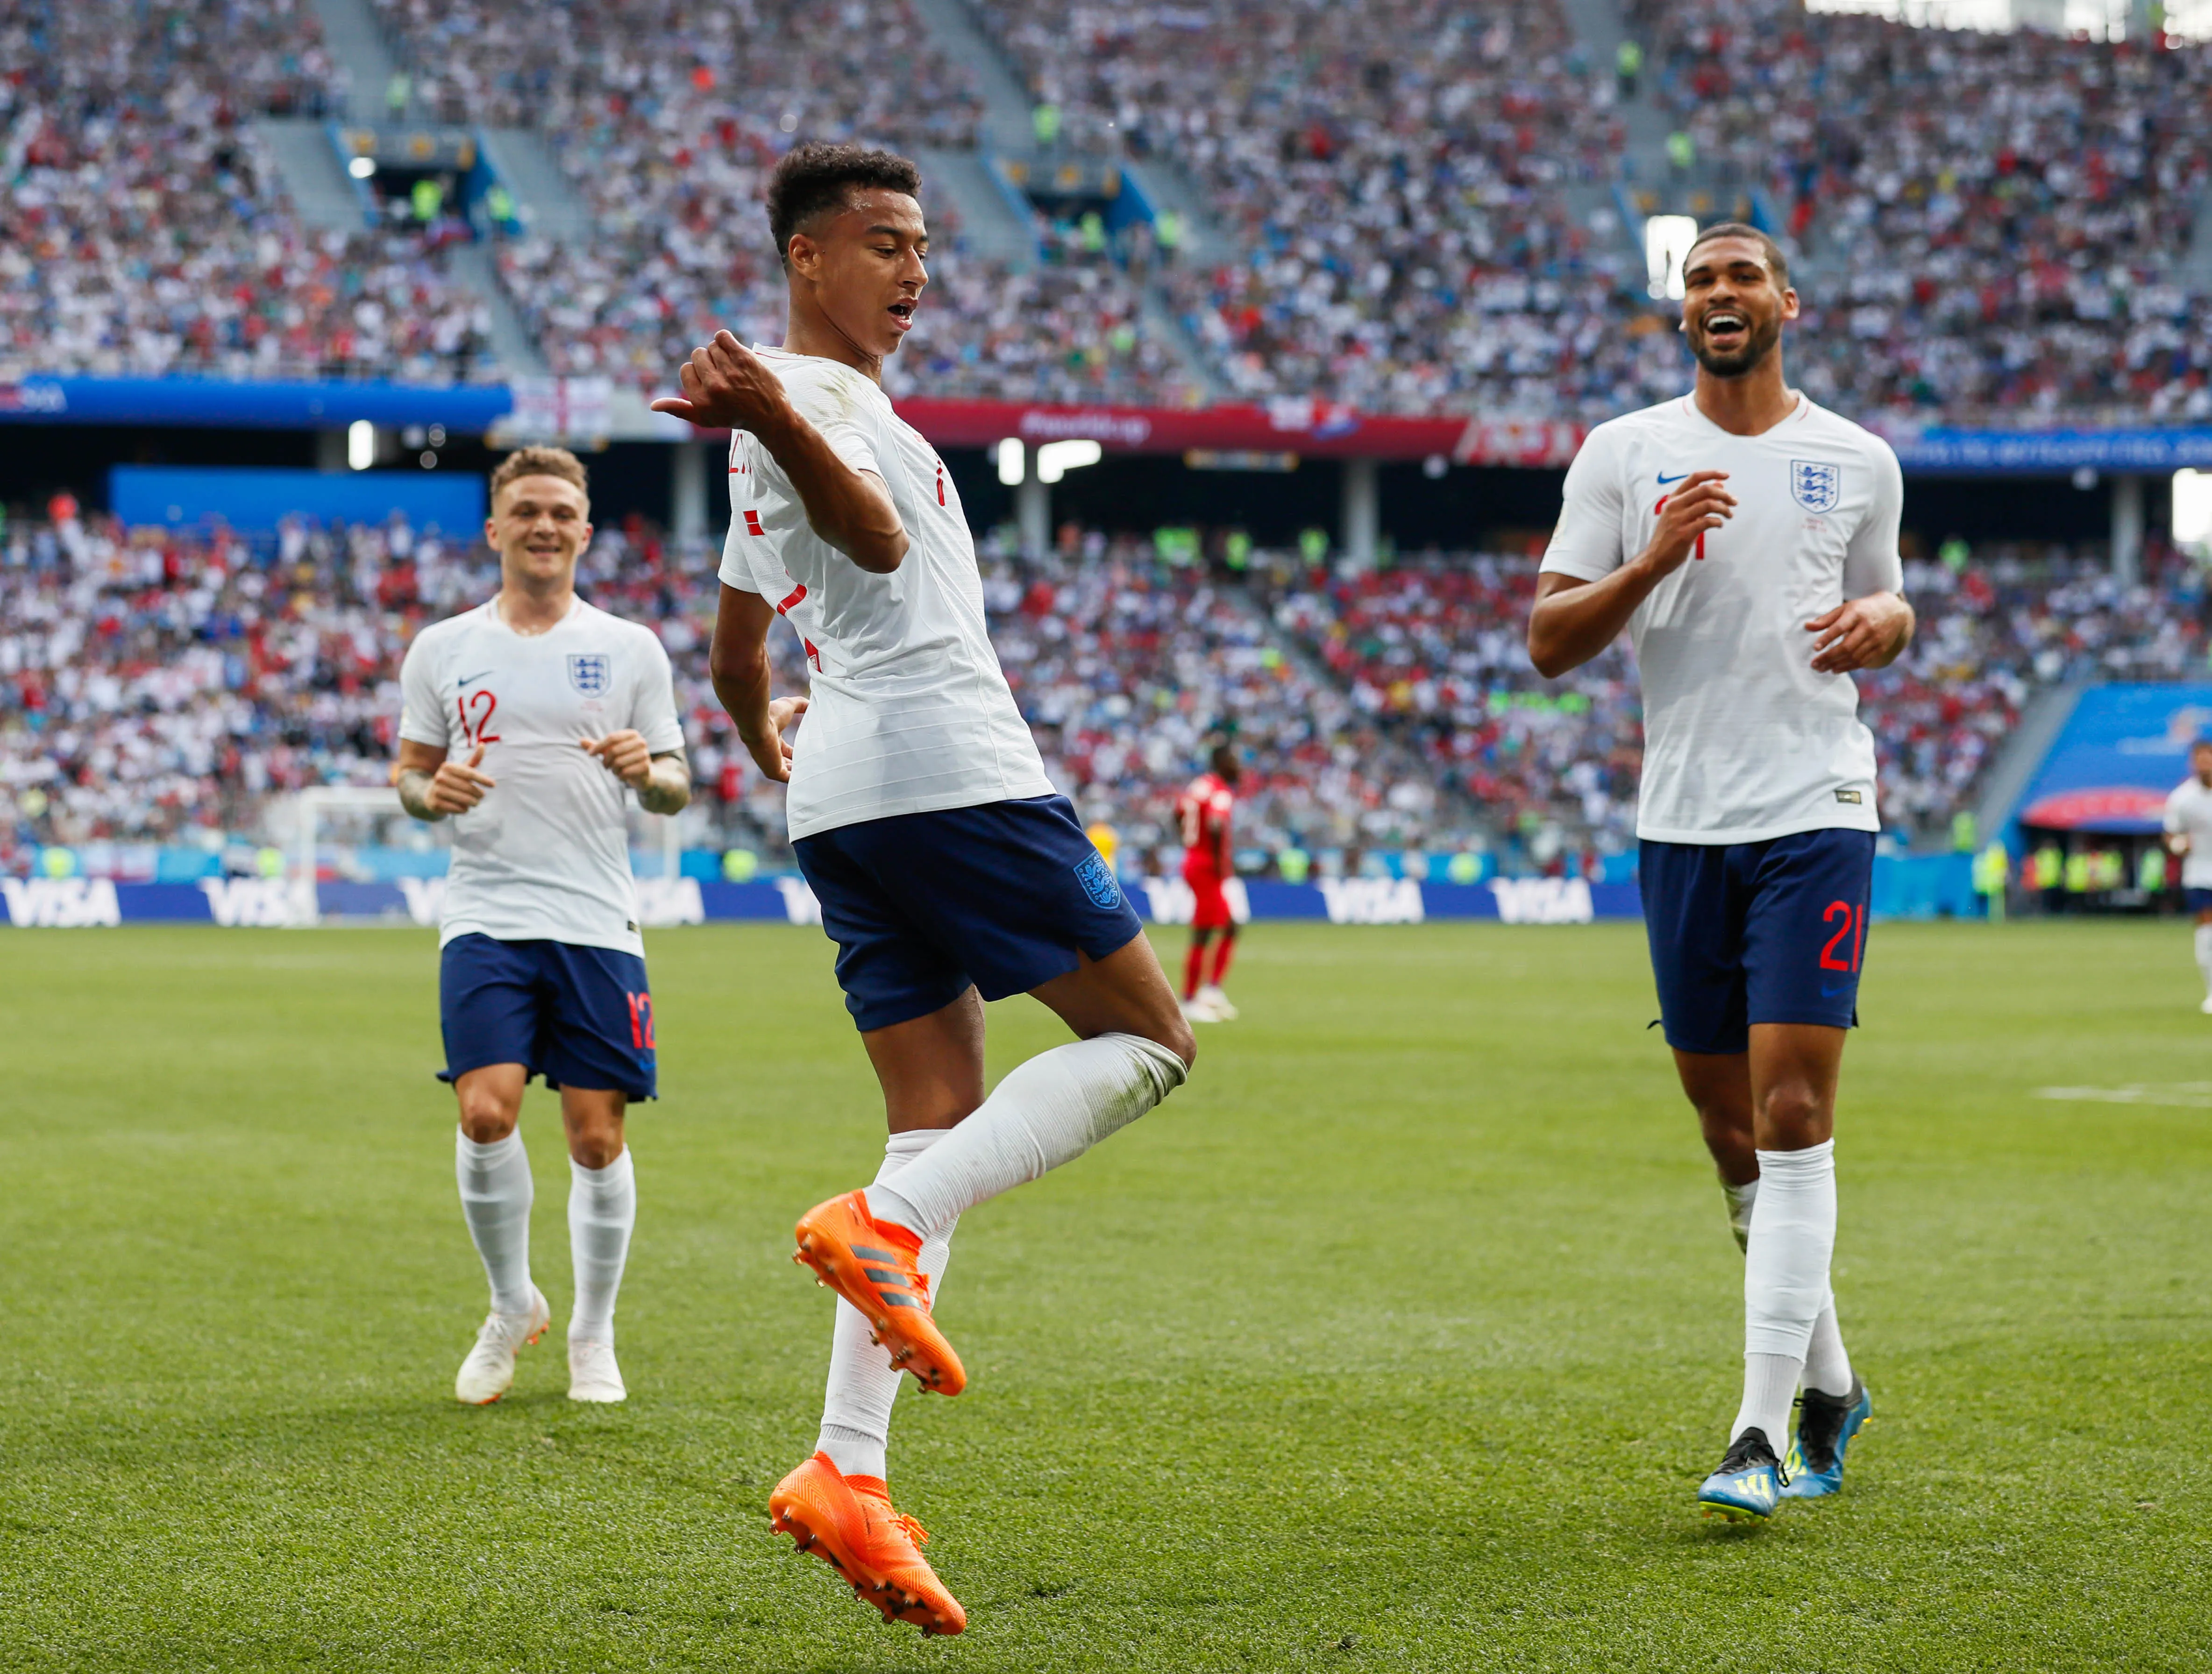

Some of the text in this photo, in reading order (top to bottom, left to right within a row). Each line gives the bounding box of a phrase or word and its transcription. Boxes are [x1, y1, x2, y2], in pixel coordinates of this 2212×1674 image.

[458, 690, 500, 748] 12
[0, 877, 121, 927] VISA
[1316, 876, 1425, 923] VISA
[1489, 877, 1594, 923] VISA
[1820, 900, 1863, 972] 21
[627, 991, 656, 1049] 12
